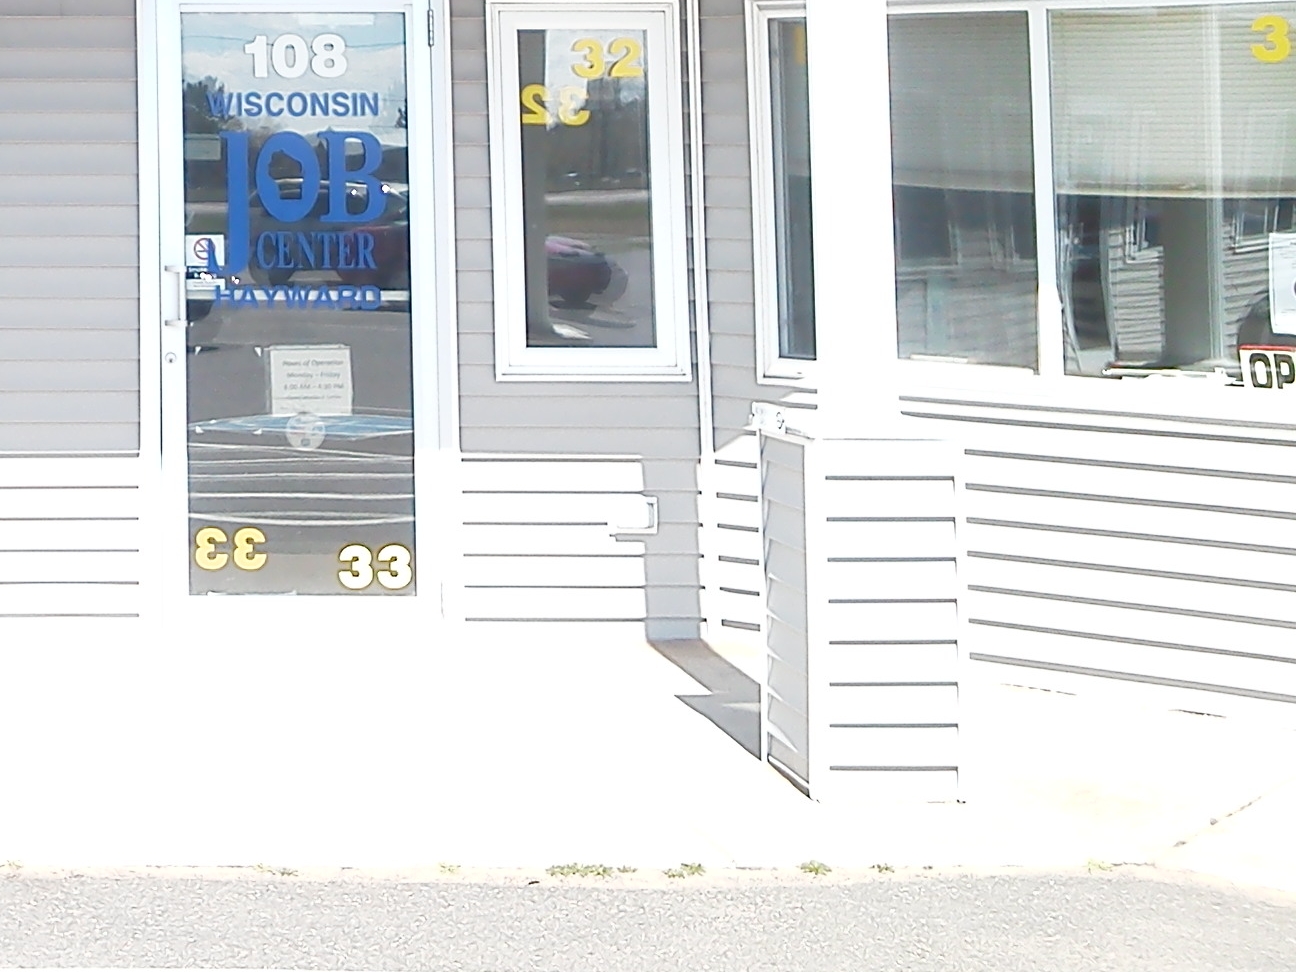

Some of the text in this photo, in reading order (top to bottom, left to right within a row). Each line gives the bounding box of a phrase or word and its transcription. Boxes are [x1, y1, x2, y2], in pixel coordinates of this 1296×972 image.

[244, 33, 347, 78] 108
[571, 37, 644, 80] 32
[207, 91, 379, 117] WISCONSIN
[208, 130, 388, 276] JOB
[257, 231, 378, 270] CENTER
[216, 285, 381, 310] HAYWARD
[337, 544, 413, 590] 33
